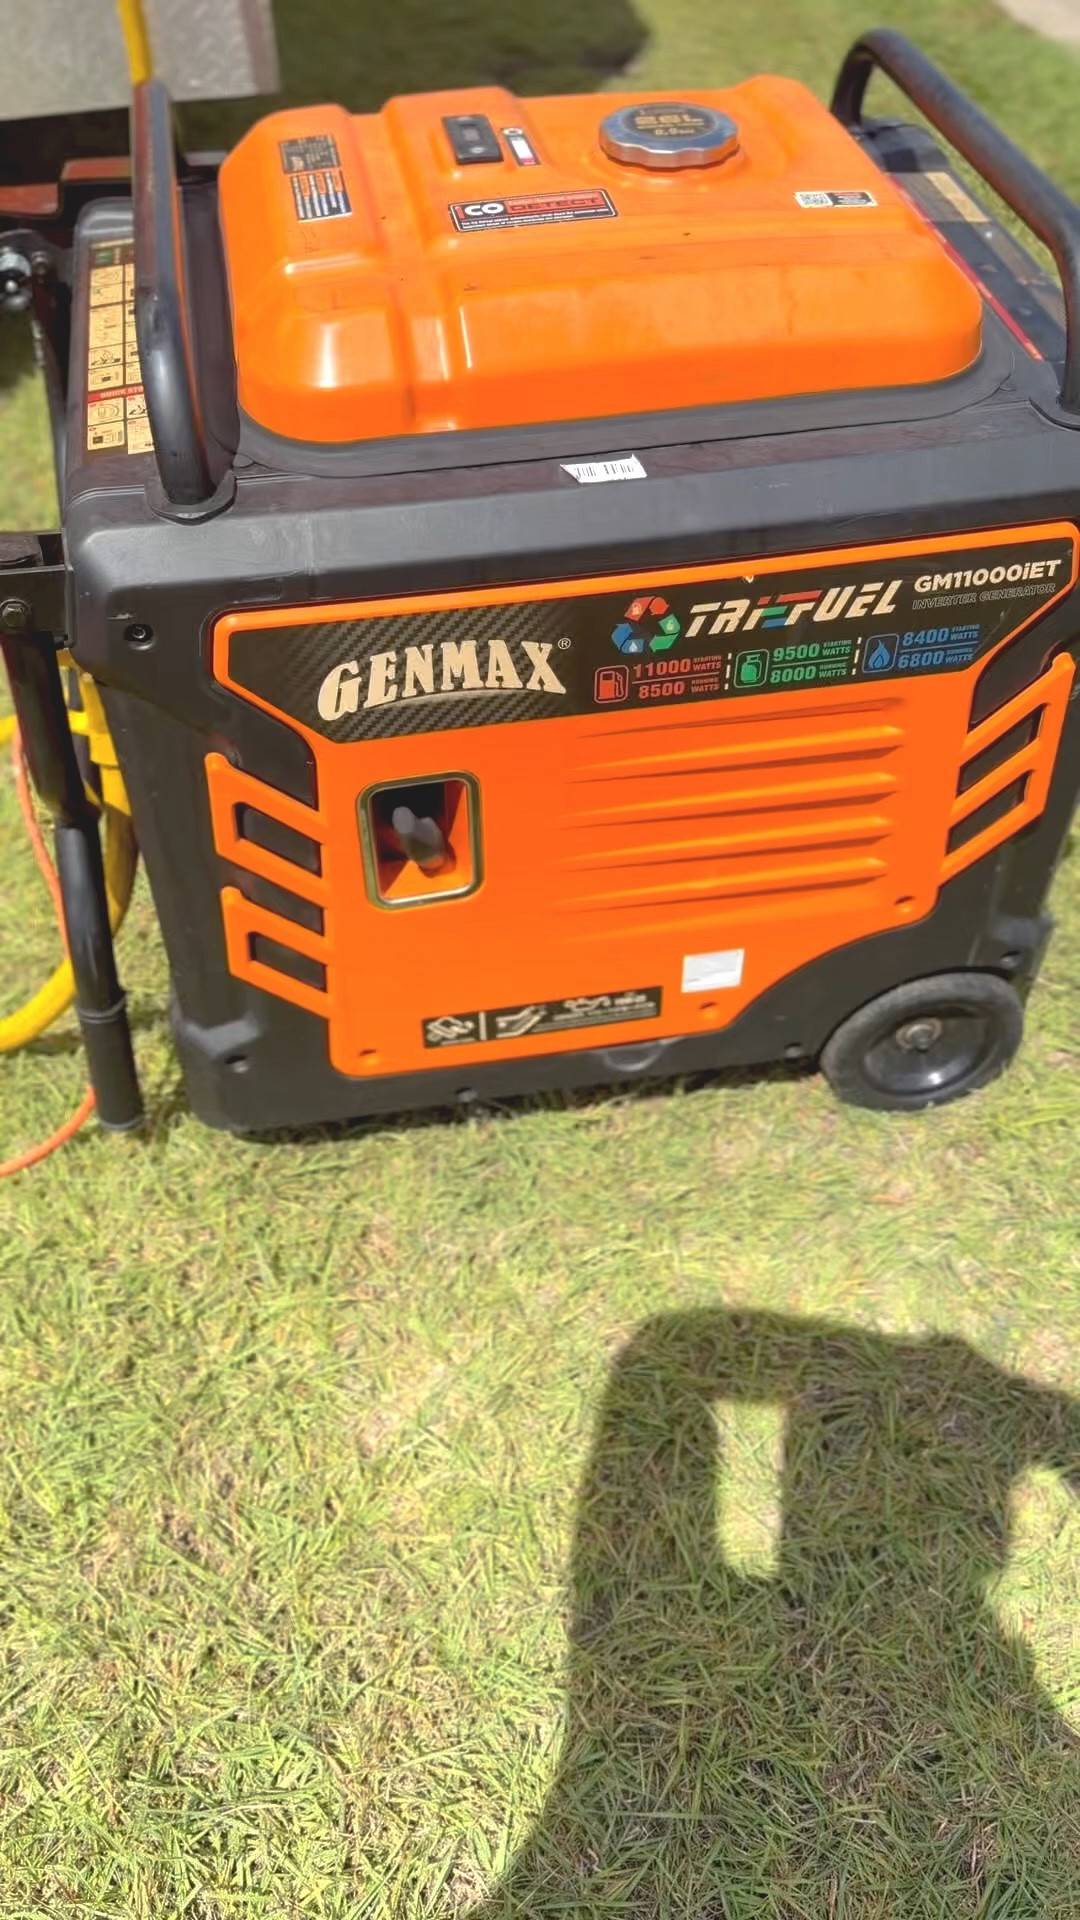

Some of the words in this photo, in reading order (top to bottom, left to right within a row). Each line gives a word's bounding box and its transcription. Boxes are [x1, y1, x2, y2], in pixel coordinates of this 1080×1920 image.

[465, 203, 504, 216] CO
[510, 198, 599, 212] DETECT
[914, 559, 1062, 593] GM11000iET
[912, 590, 976, 610] INVERTER
[979, 583, 1056, 602] GENERATOR
[902, 627, 949, 647] 8400
[950, 631, 978, 641] WATTS
[773, 643, 820, 662] 9500
[822, 646, 851, 656] WATTS
[945, 654, 974, 664] WATTS
[692, 661, 722, 672] WATTS
[897, 650, 945, 669] 6800
[633, 658, 692, 678] 11000
[770, 665, 817, 684] 8000
[819, 668, 848, 678] WATTS
[638, 681, 686, 699] 8500
[691, 683, 720, 693] WATTS
